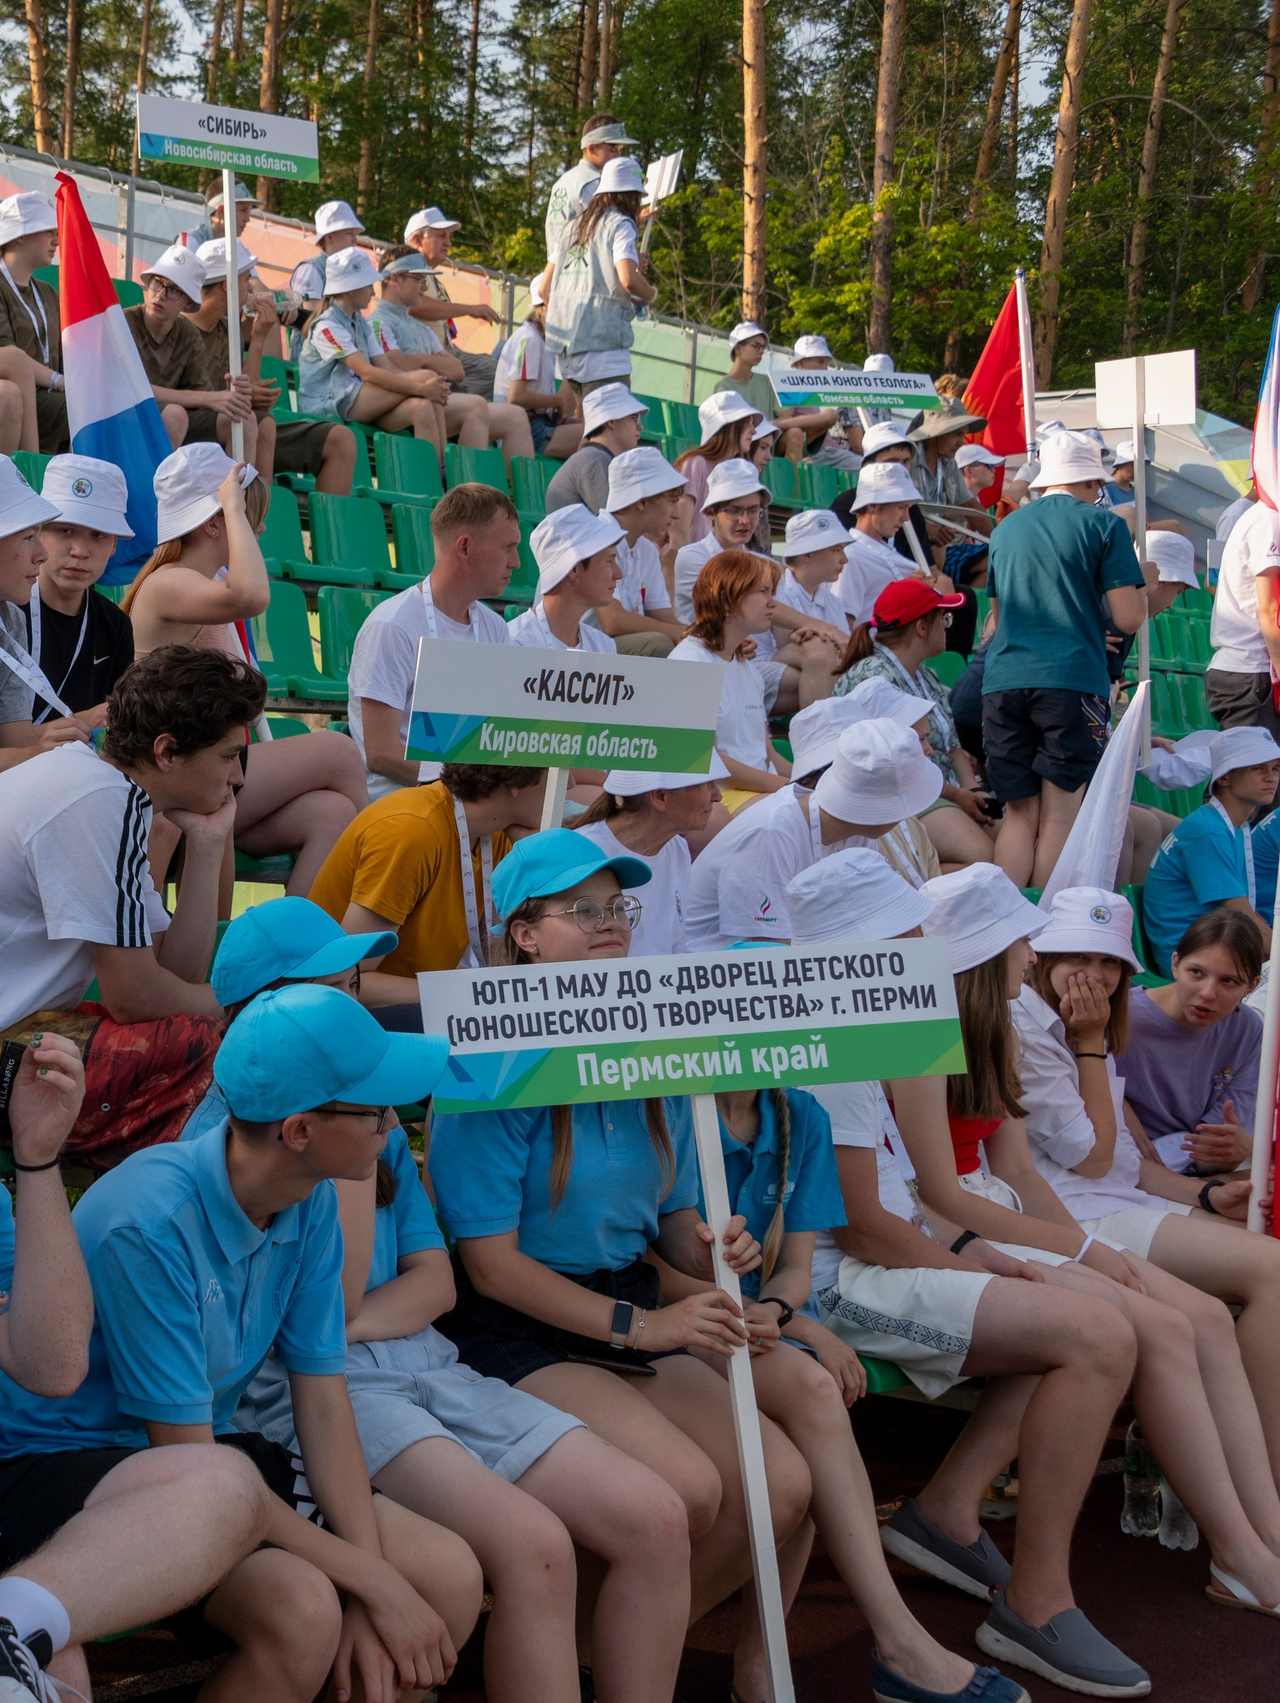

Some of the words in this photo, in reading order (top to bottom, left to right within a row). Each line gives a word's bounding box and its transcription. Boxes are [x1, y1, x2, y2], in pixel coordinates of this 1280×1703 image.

[197, 115, 267, 140] «СИБИРЬ»
[164, 138, 252, 167] Новосибирская
[254, 153, 298, 173] область
[780, 375, 831, 387] «ШКОЛА
[832, 376, 872, 388] ЮНОГО
[873, 377, 926, 390] ГЕОЛОГА»
[817, 393, 862, 404] Томская
[863, 393, 905, 405] область
[523, 668, 635, 706] «КАССИТ»
[478, 722, 582, 759] Кировская
[586, 729, 658, 759] область
[472, 975, 549, 1006] ЮГП-1
[556, 972, 608, 1000] МАУ
[617, 968, 652, 999] ДО
[658, 960, 777, 995] «ДВОРЕЦ
[782, 951, 905, 988] ДЕТСКОГО
[446, 1001, 647, 1047] (ЮНОШЕСКОГО)
[652, 993, 824, 1028] ТВОРЧЕСТВА»
[831, 996, 847, 1015] г.
[851, 984, 937, 1014] ПЕРМИ
[576, 1041, 743, 1092] Пермский
[750, 1034, 829, 1080] край
